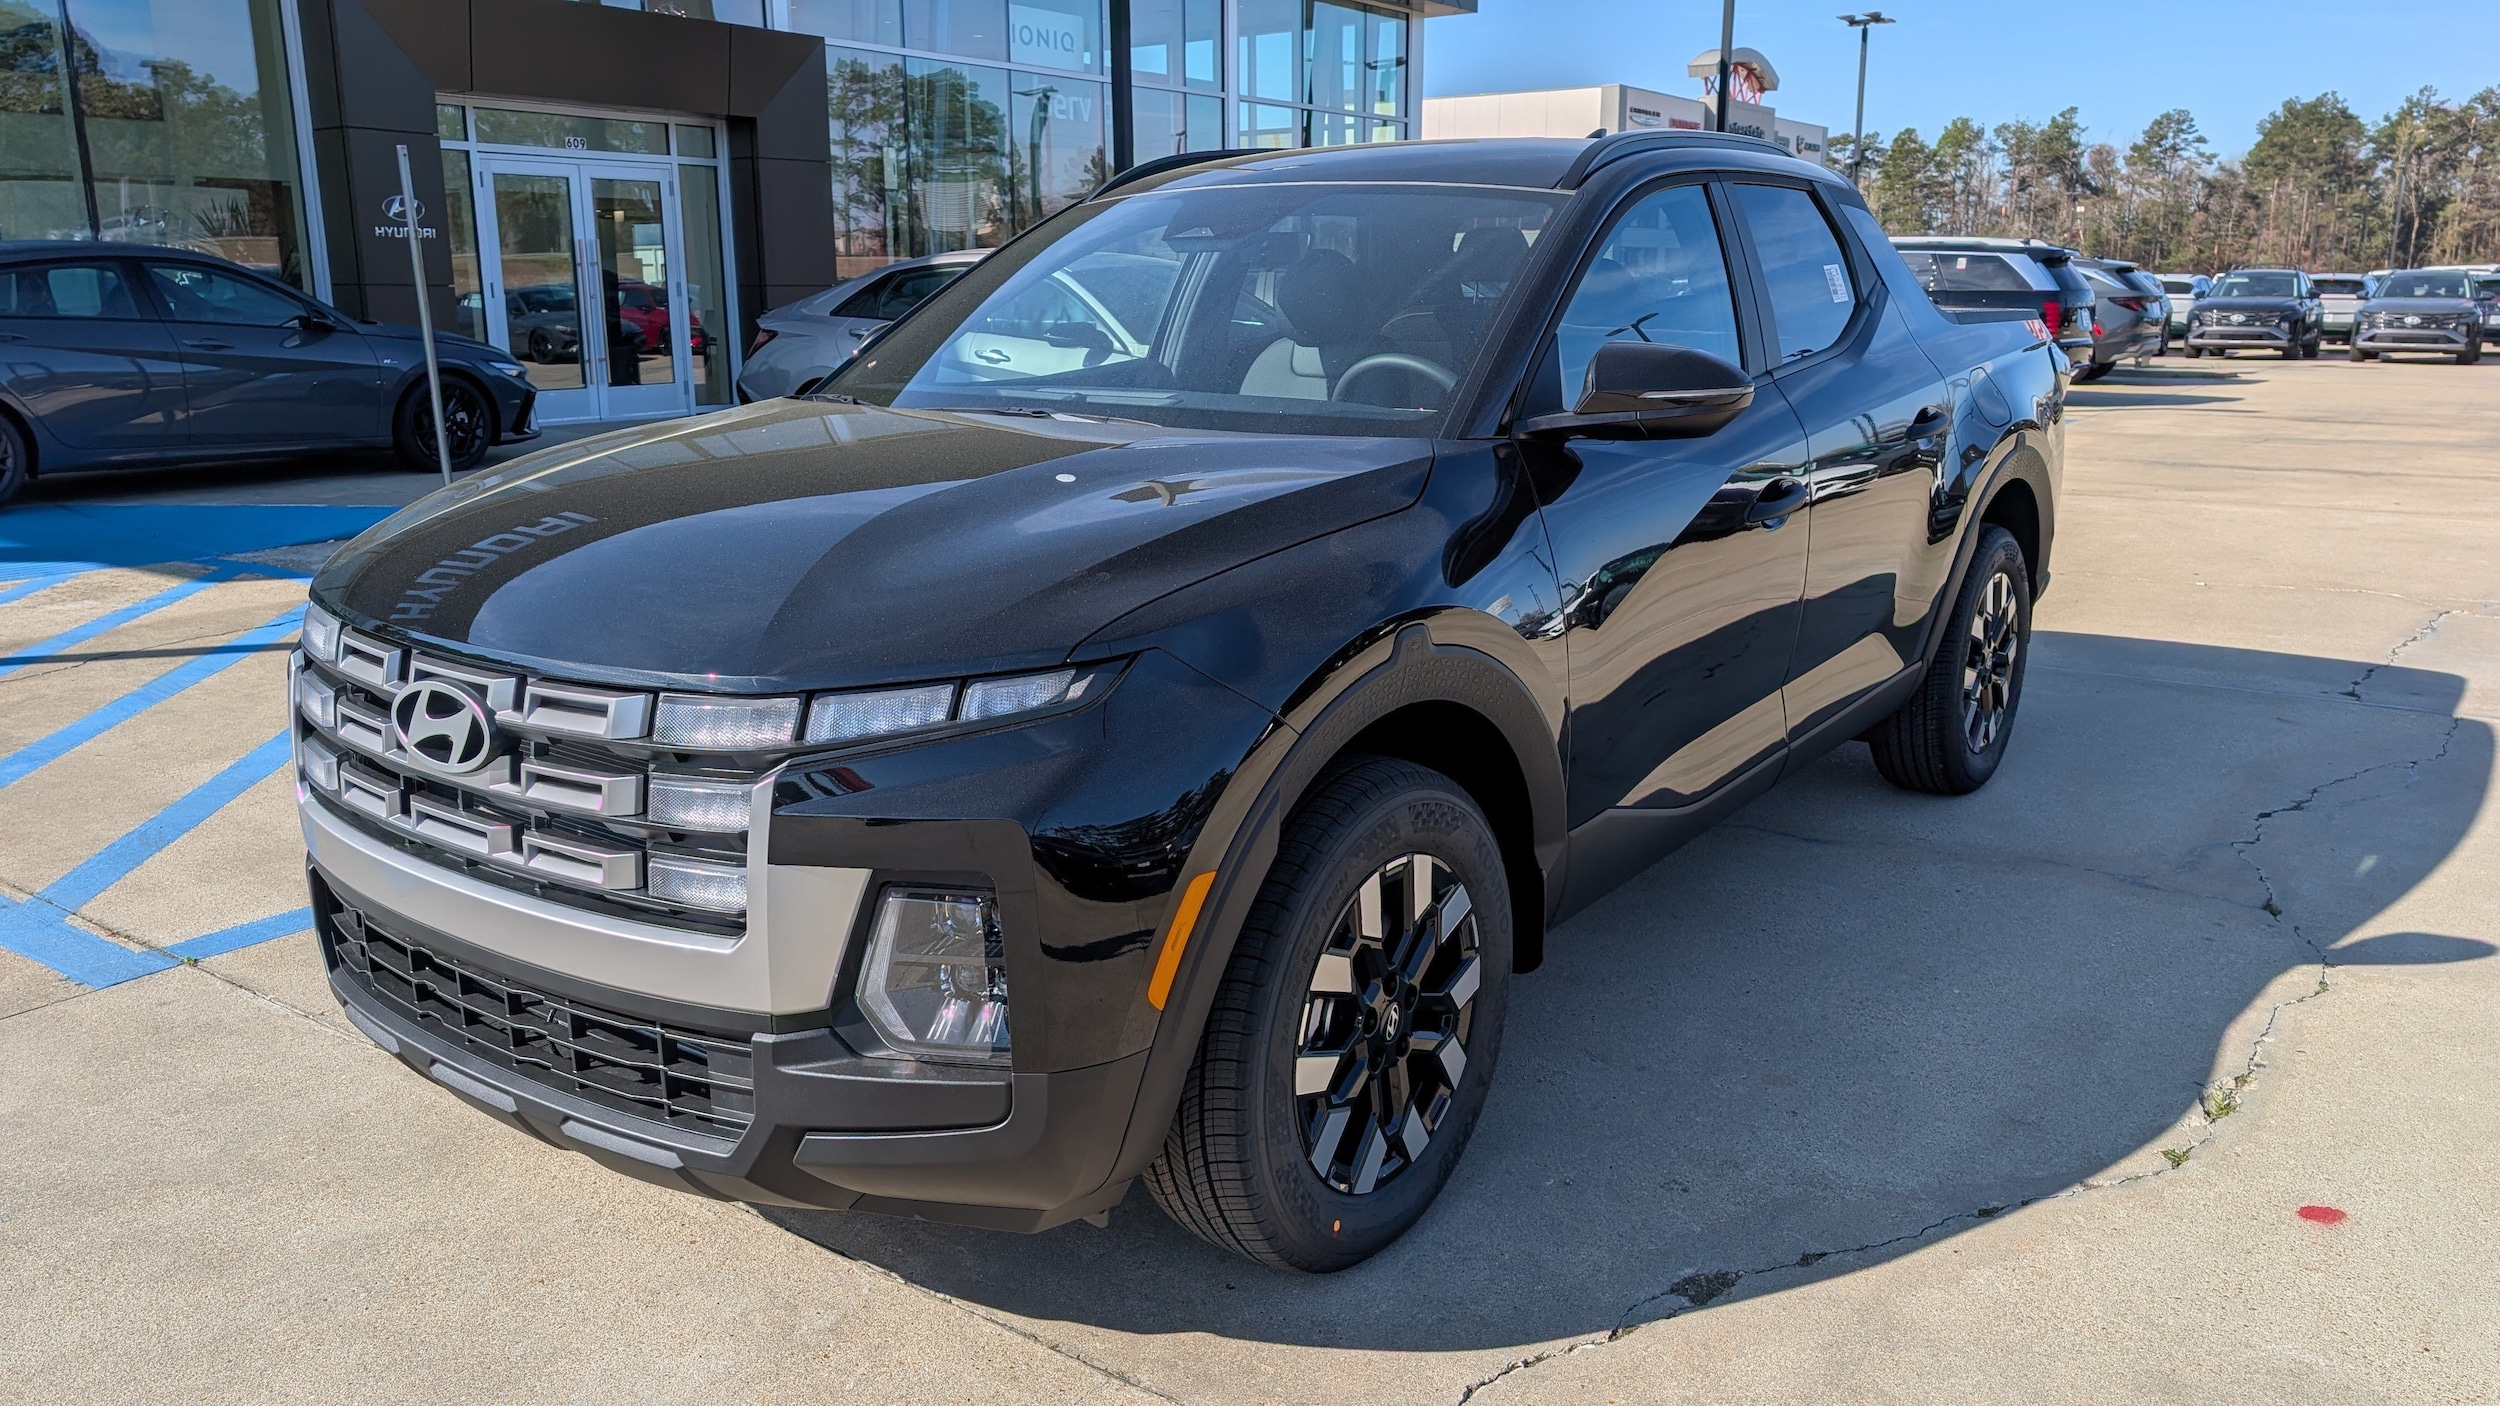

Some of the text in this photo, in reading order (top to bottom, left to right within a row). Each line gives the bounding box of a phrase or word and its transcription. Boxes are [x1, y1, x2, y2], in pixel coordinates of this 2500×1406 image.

[1012, 23, 1075, 53] IONIQ
[566, 138, 585, 149] 609
[1475, 834, 1509, 935] KUMHO
